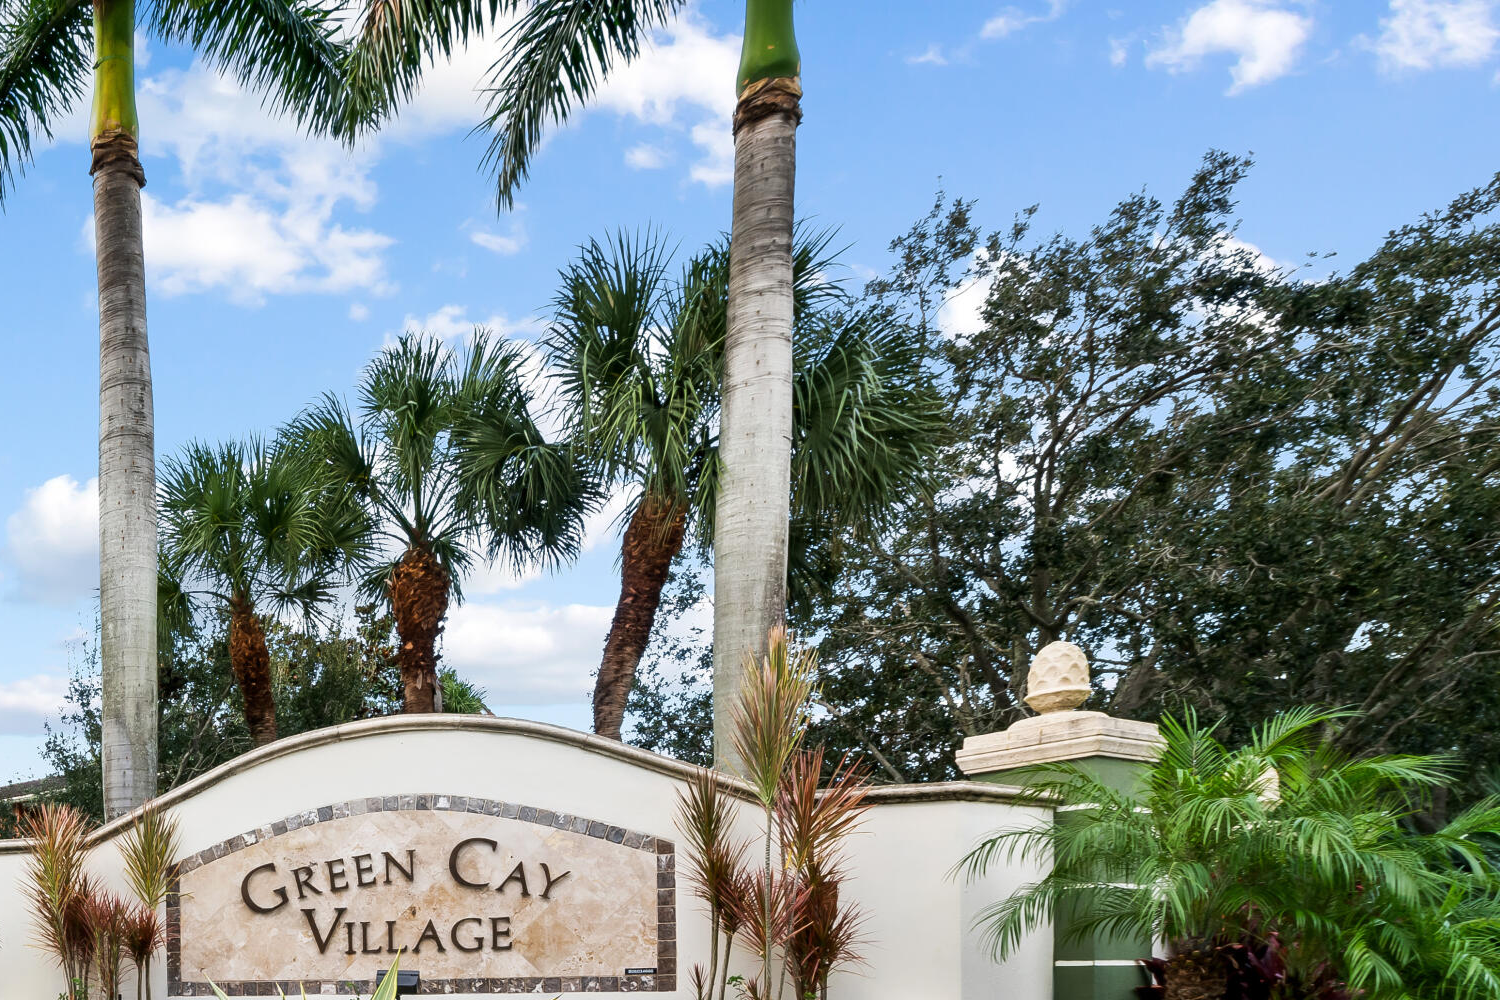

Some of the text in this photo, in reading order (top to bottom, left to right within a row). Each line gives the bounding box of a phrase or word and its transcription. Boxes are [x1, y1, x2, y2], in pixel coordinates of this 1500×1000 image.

[241, 837, 571, 914] GREEN CAY
[300, 907, 513, 954] VILLAGE
